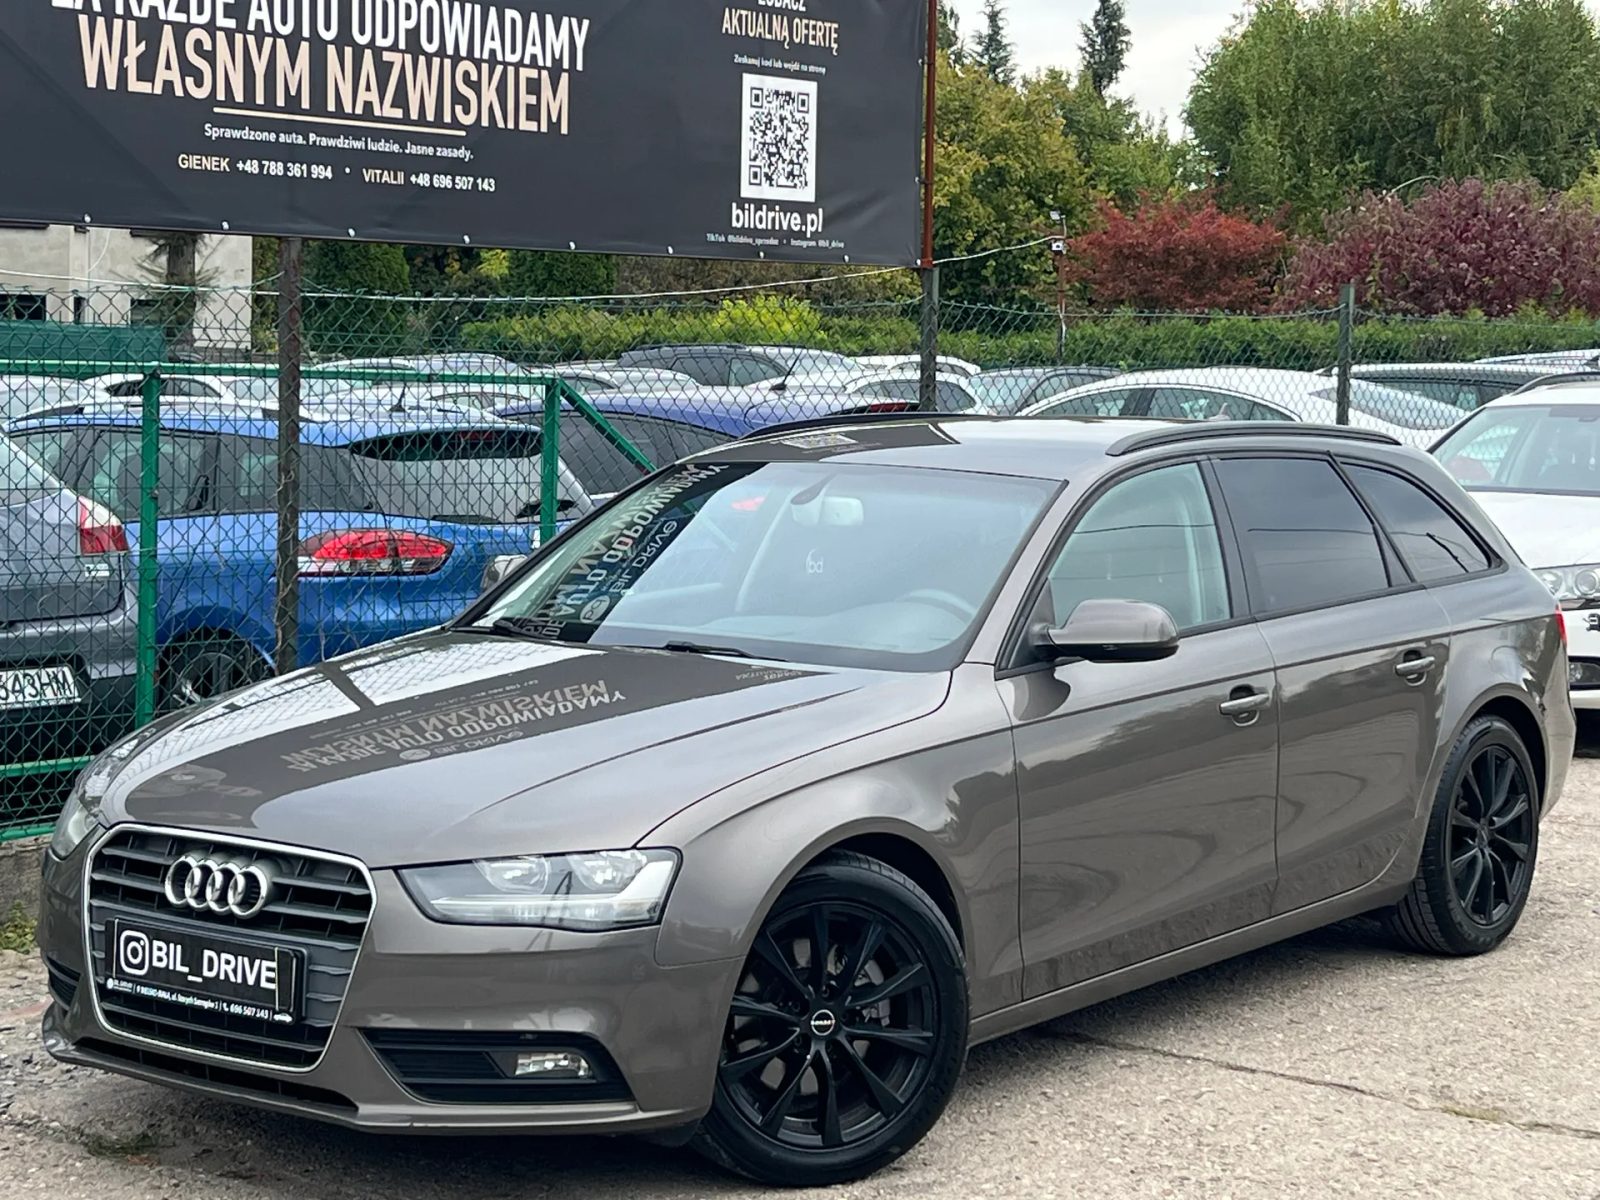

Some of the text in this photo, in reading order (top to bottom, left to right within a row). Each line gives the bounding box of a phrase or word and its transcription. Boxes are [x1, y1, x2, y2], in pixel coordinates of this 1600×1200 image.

[247, 0, 339, 41] AUTO
[351, 0, 590, 71] ODPOWIADAMY
[722, 7, 839, 56] AKTUALNĄ OFERTĘ
[77, 13, 569, 135] WŁASNYM NAZWISKIEM
[204, 123, 475, 162] Sprawdzone auta. Prawdziwi ludzie. Jasne zasady.
[178, 154, 333, 180] GIENEK +48 788 361 994
[362, 168, 497, 192] VITALII +48 696 507 143
[731, 202, 824, 238] bildrive.pl
[151, 939, 276, 989] BIL_DRIVE
